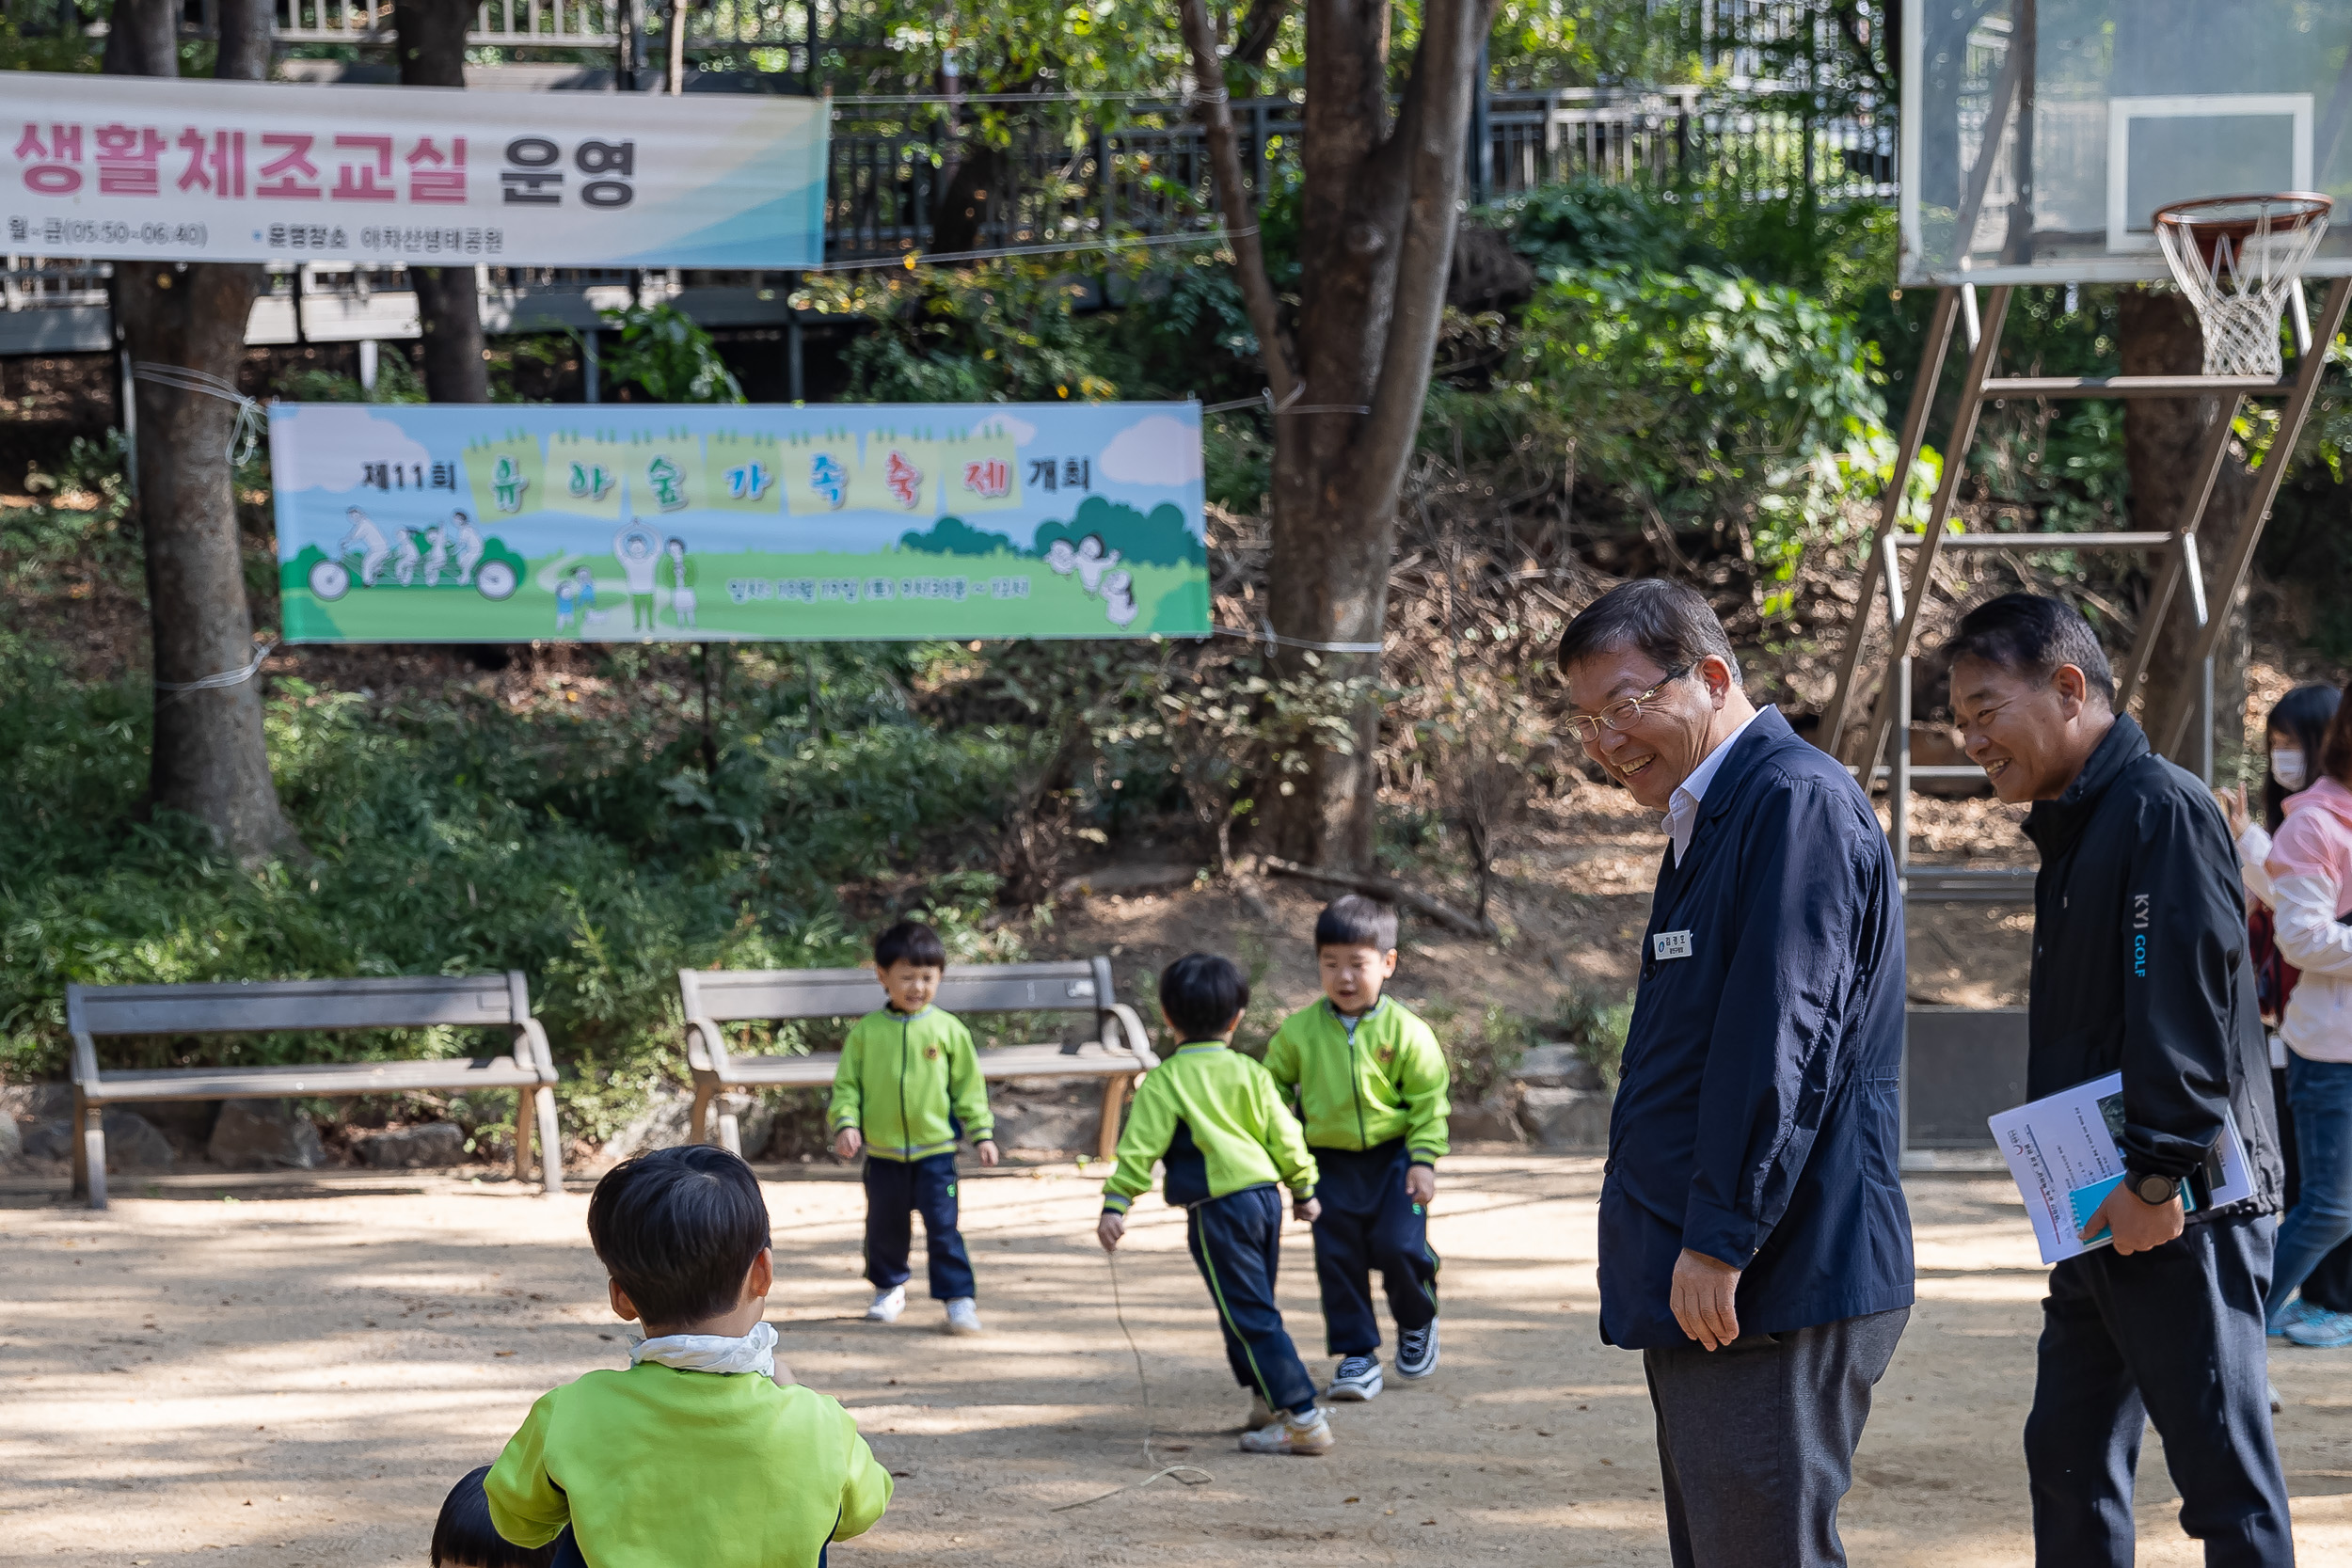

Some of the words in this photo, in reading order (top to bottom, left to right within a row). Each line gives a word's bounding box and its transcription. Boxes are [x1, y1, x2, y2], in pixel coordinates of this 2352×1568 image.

[14, 122, 467, 204] 생활체조교실
[501, 136, 635, 209] 운영
[361, 460, 456, 492] 제11회
[1027, 455, 1090, 492] 개최
[2133, 894, 2149, 928] KYJ
[2135, 934, 2146, 977] GOLF
